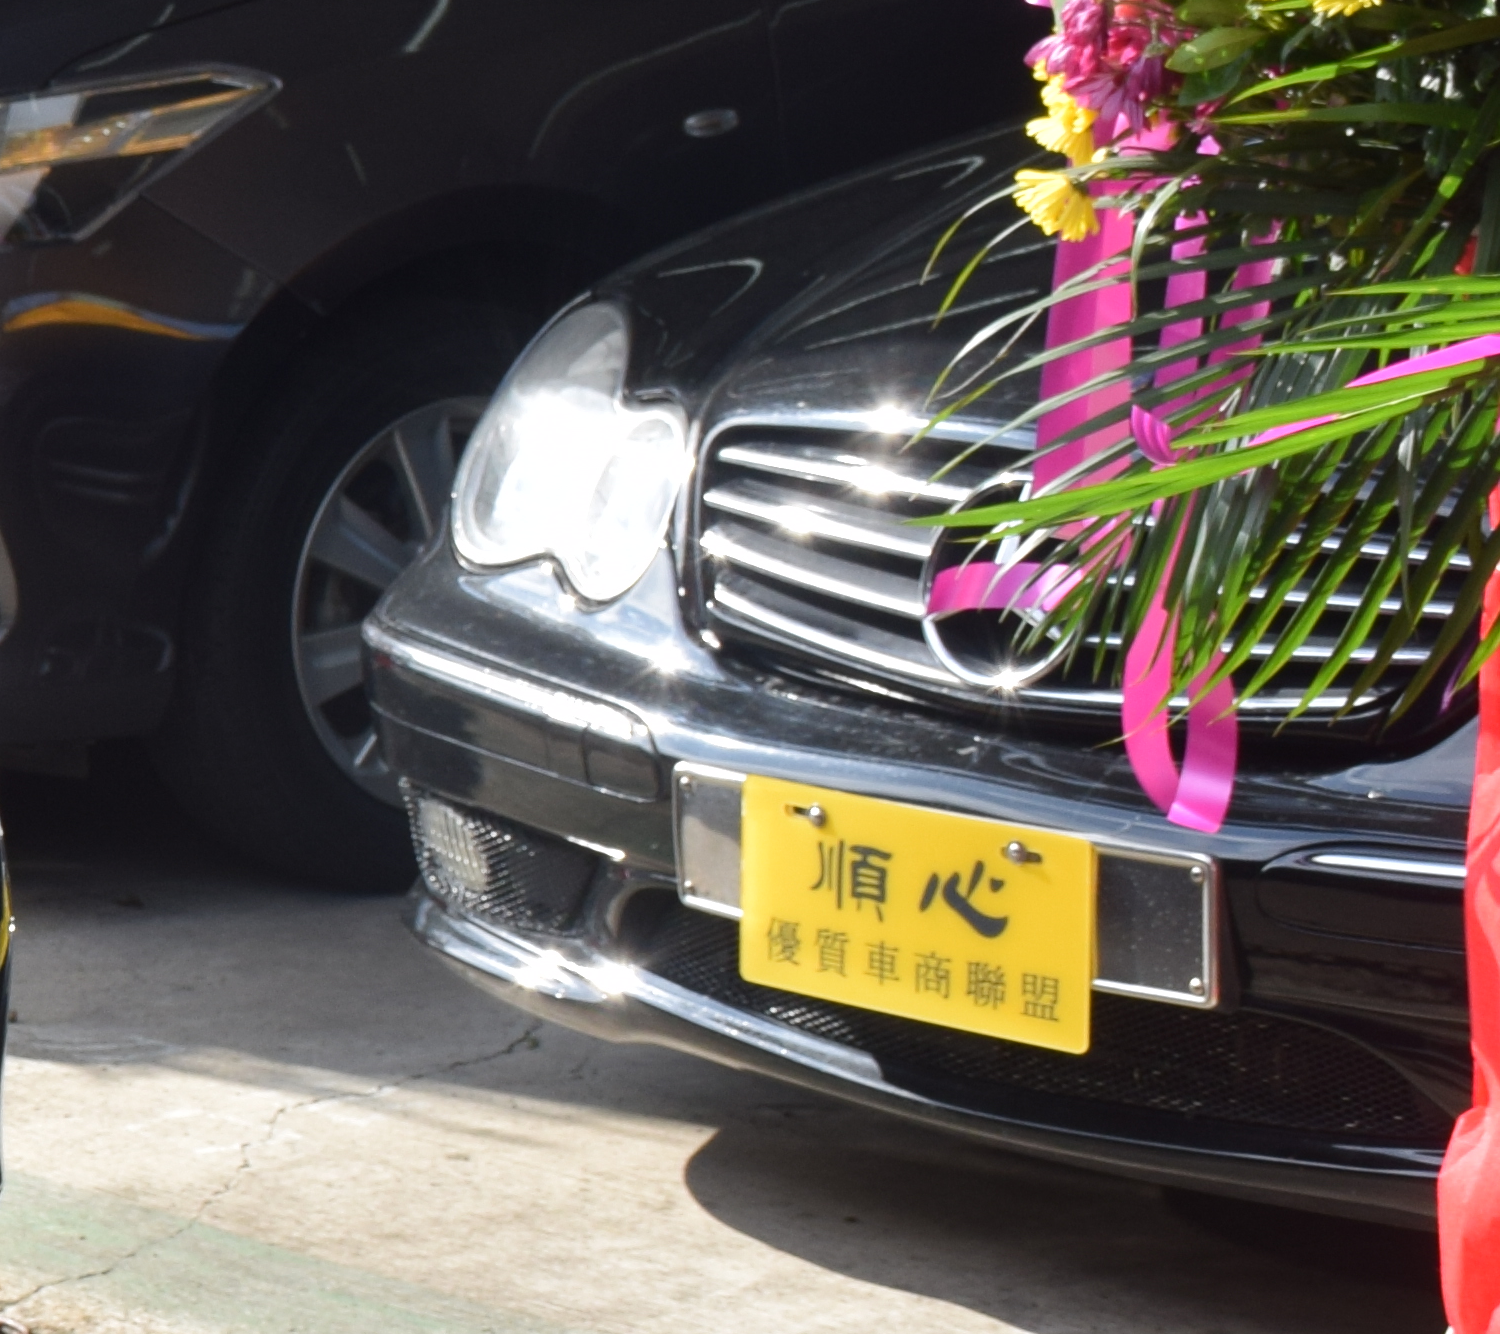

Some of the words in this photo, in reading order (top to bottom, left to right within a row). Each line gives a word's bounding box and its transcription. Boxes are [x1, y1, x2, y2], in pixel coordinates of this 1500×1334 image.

[810, 839, 1010, 939] 順心
[764, 916, 1062, 1023] 優質車商聯盟
